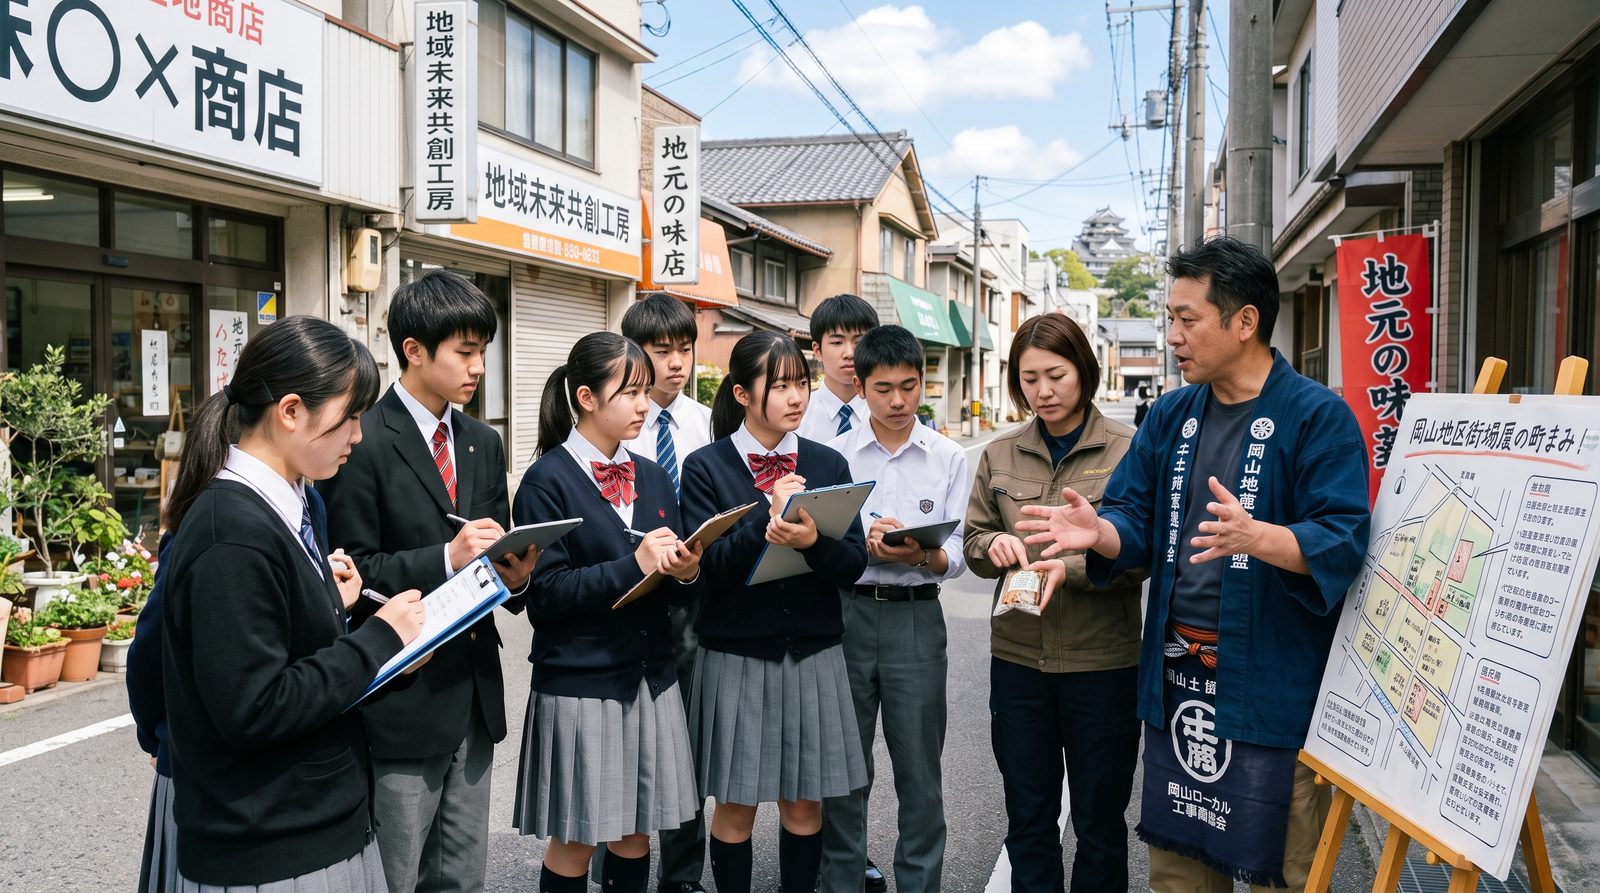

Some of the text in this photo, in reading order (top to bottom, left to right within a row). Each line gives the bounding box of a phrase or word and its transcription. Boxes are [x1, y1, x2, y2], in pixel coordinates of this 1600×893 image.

[427, 11, 454, 211] 地域未来共創工房
[485, 162, 630, 243] 地域未来共創工房
[661, 135, 688, 277] 地元の味店
[1168, 781, 1232, 815] 岡山ローカル
